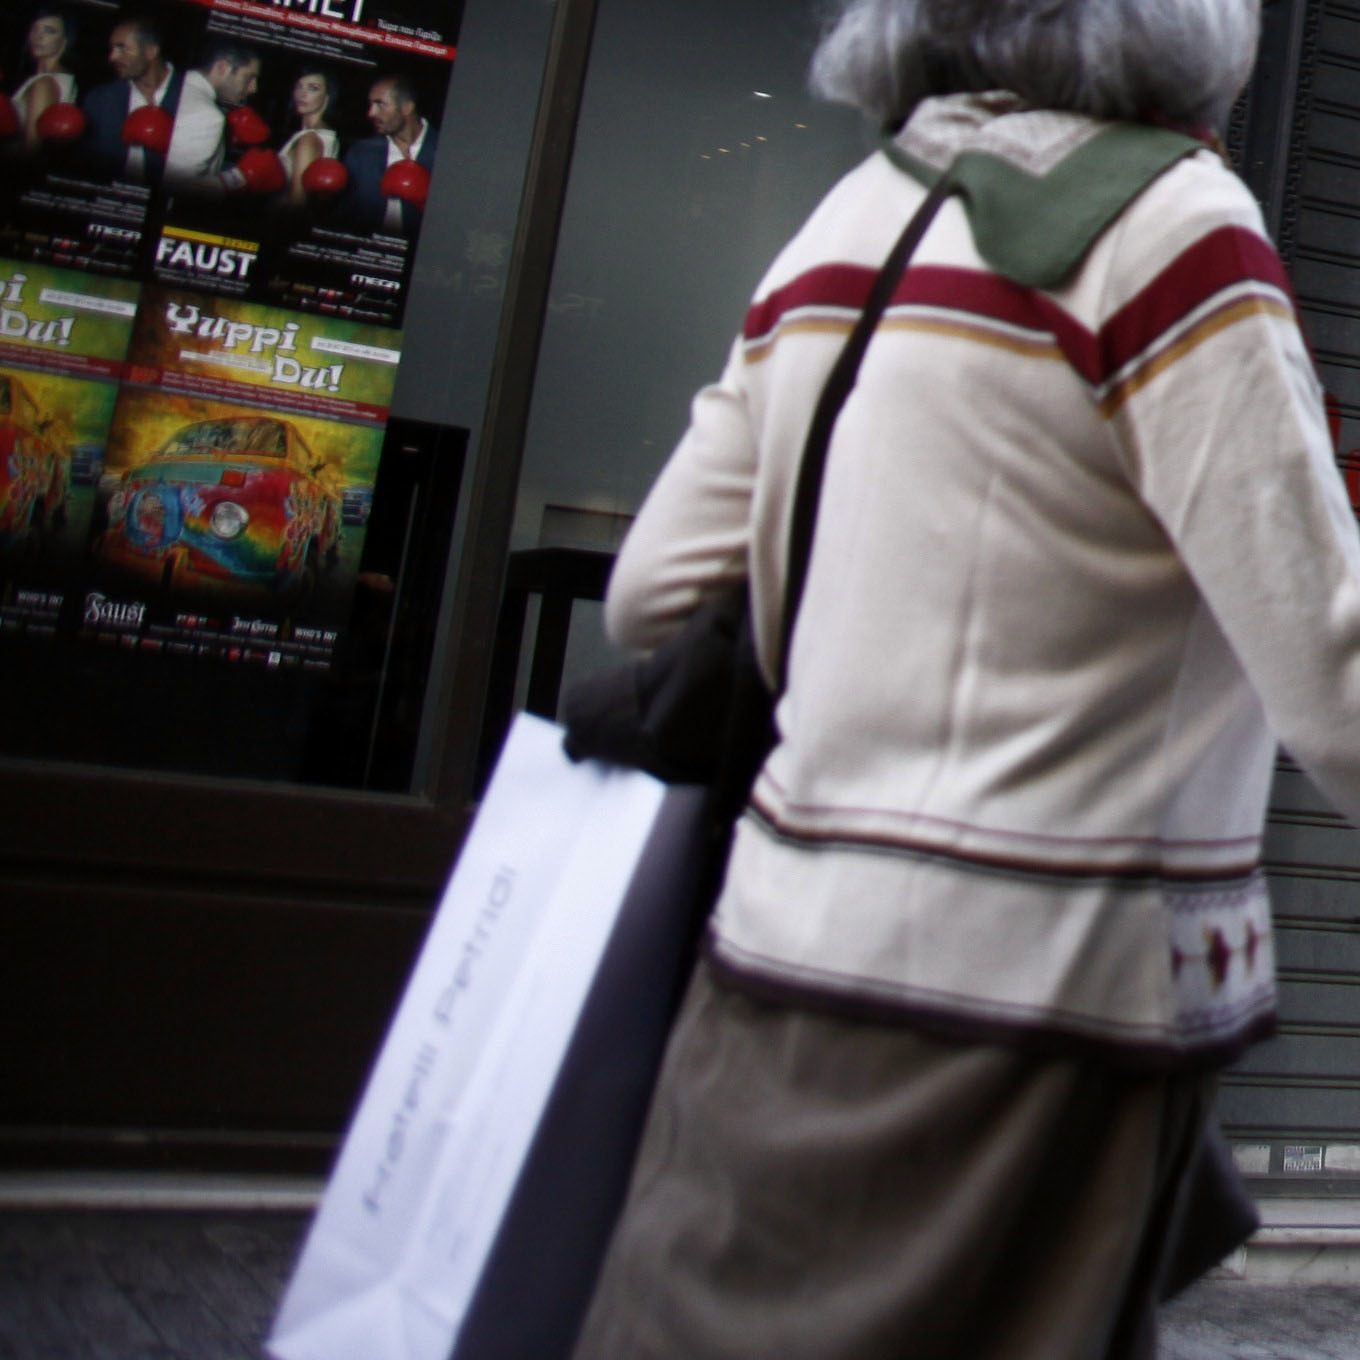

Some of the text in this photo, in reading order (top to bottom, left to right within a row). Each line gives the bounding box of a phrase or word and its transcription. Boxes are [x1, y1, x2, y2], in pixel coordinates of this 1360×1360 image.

[153, 237, 259, 278] FAUST
[166, 302, 300, 353] Yuppi
[272, 354, 345, 392] Du!
